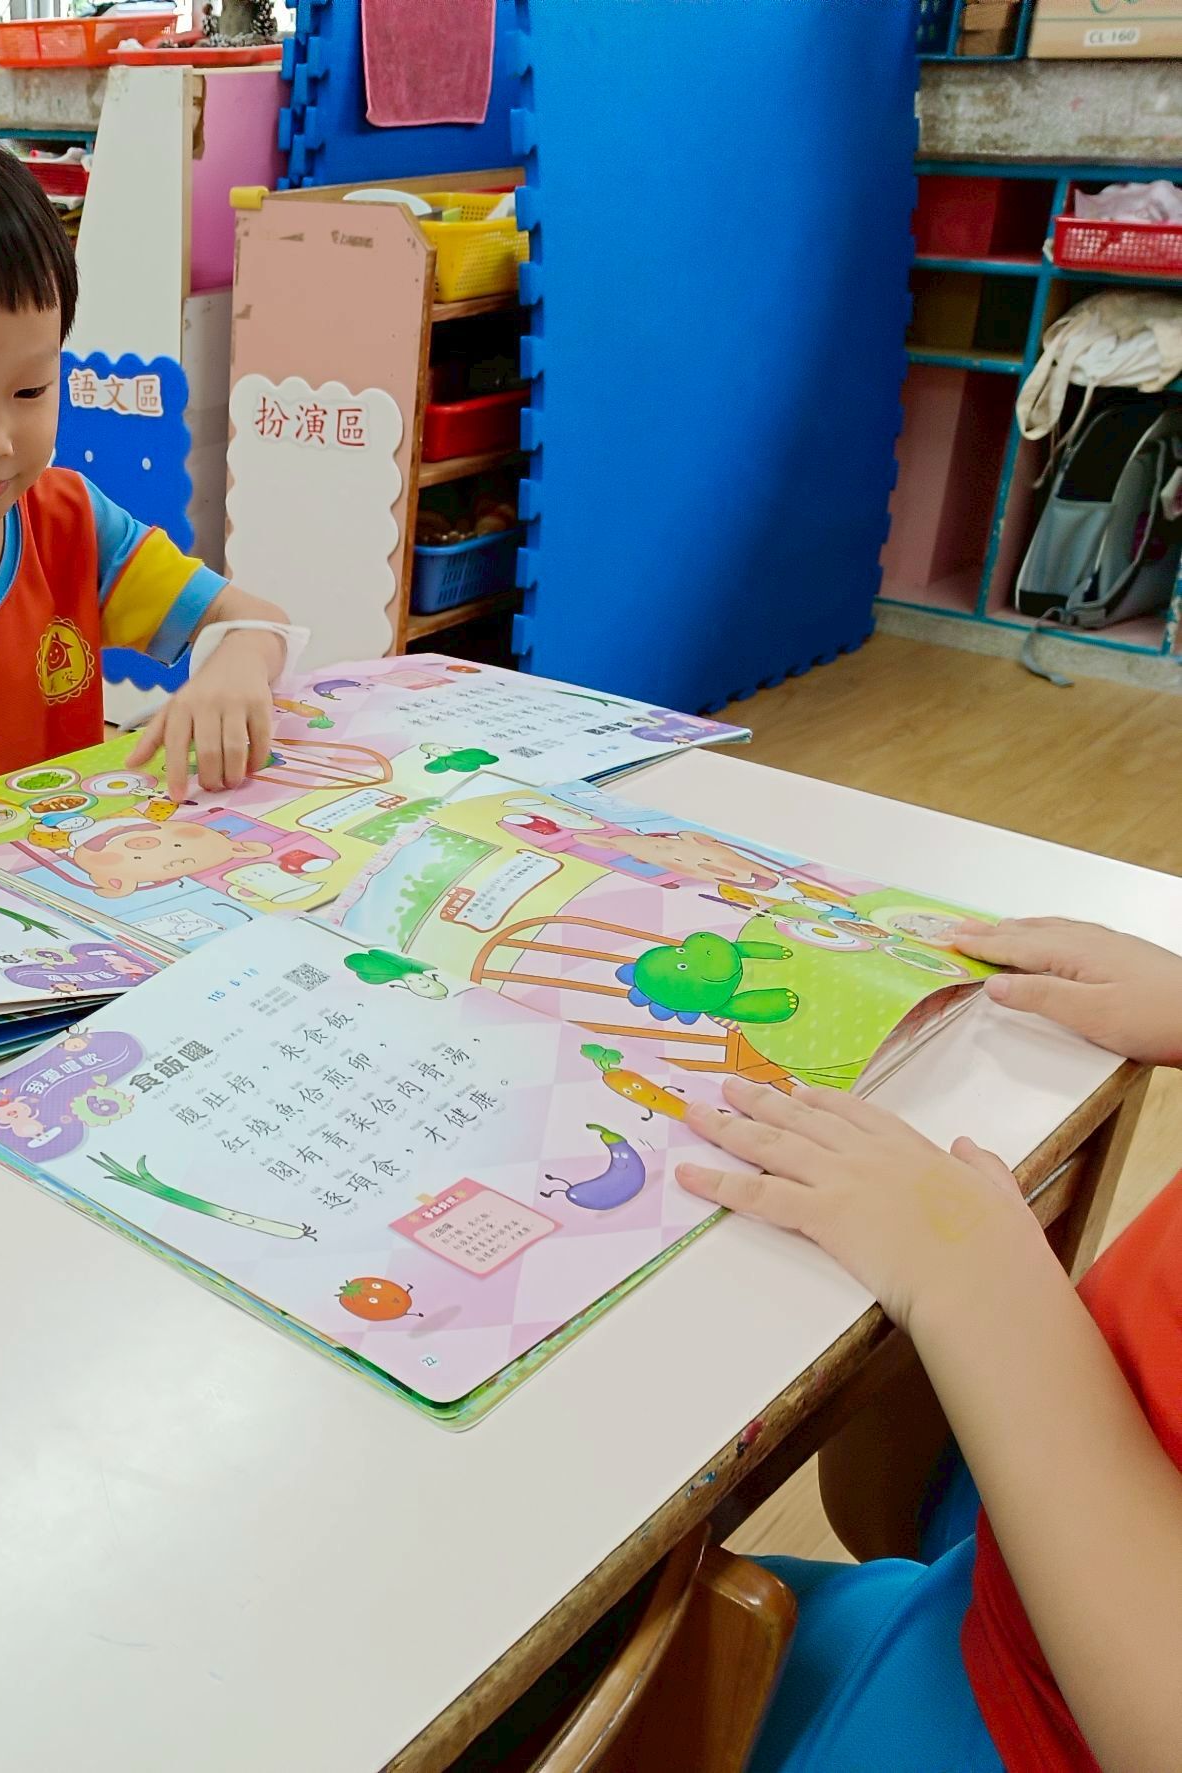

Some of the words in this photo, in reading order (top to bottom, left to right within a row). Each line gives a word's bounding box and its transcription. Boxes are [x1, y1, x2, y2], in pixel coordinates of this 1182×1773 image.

[69, 372, 160, 413] 語文區
[254, 397, 366, 447] 扮演區
[208, 990, 226, 1002] 115
[25, 1052, 104, 1095] 我愛唱歌
[129, 1040, 213, 1094] 食飯囉
